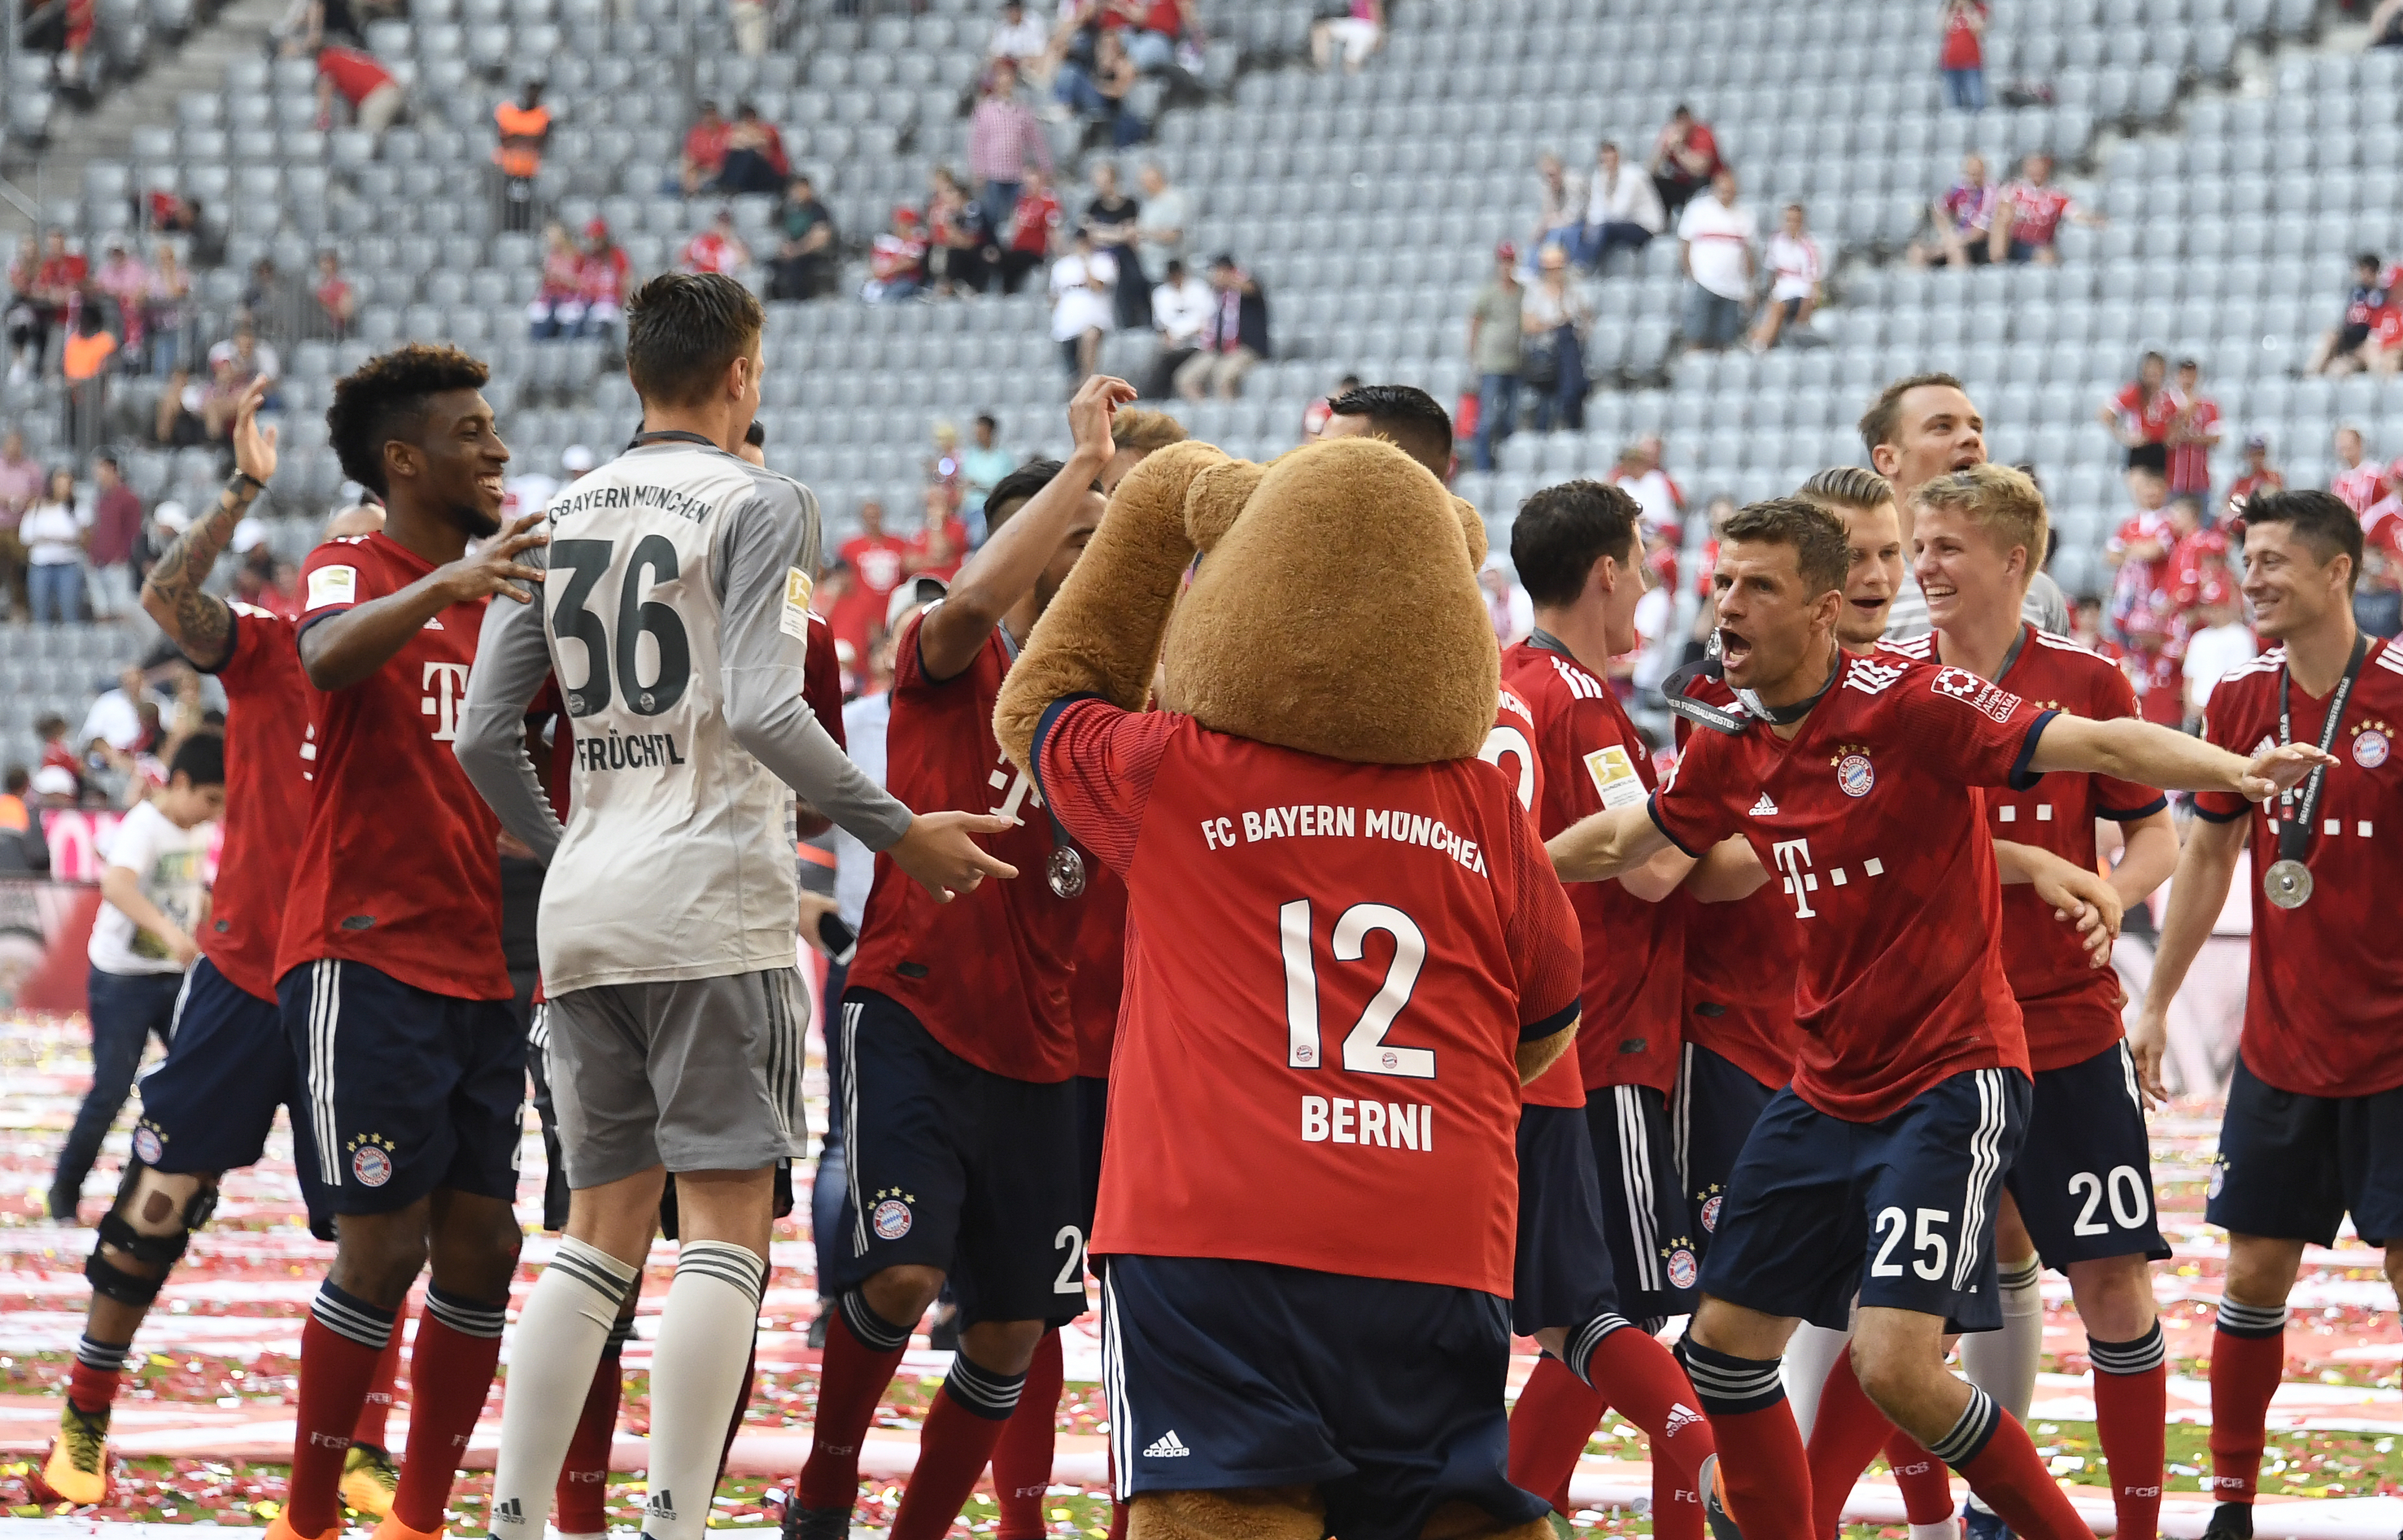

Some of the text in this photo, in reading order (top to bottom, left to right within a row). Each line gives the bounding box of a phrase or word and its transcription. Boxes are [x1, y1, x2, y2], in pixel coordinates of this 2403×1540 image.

[560, 486, 629, 516] BAYERN
[549, 535, 691, 717] 36
[576, 728, 685, 772] FRÜCHTL
[1200, 805, 1488, 879] FC BAYERN MÜNCHEN
[1278, 897, 1436, 1081] 12
[1301, 1095, 1432, 1152] BERNI
[2068, 1165, 2149, 1236] 20
[1871, 1206, 1950, 1281] 25
[309, 1430, 350, 1449] FCB
[1143, 1447, 1190, 1458] adidas
[1894, 1461, 1931, 1476] FCB
[1674, 1489, 1698, 1504] FC
[2125, 1486, 2160, 1498] FCB
